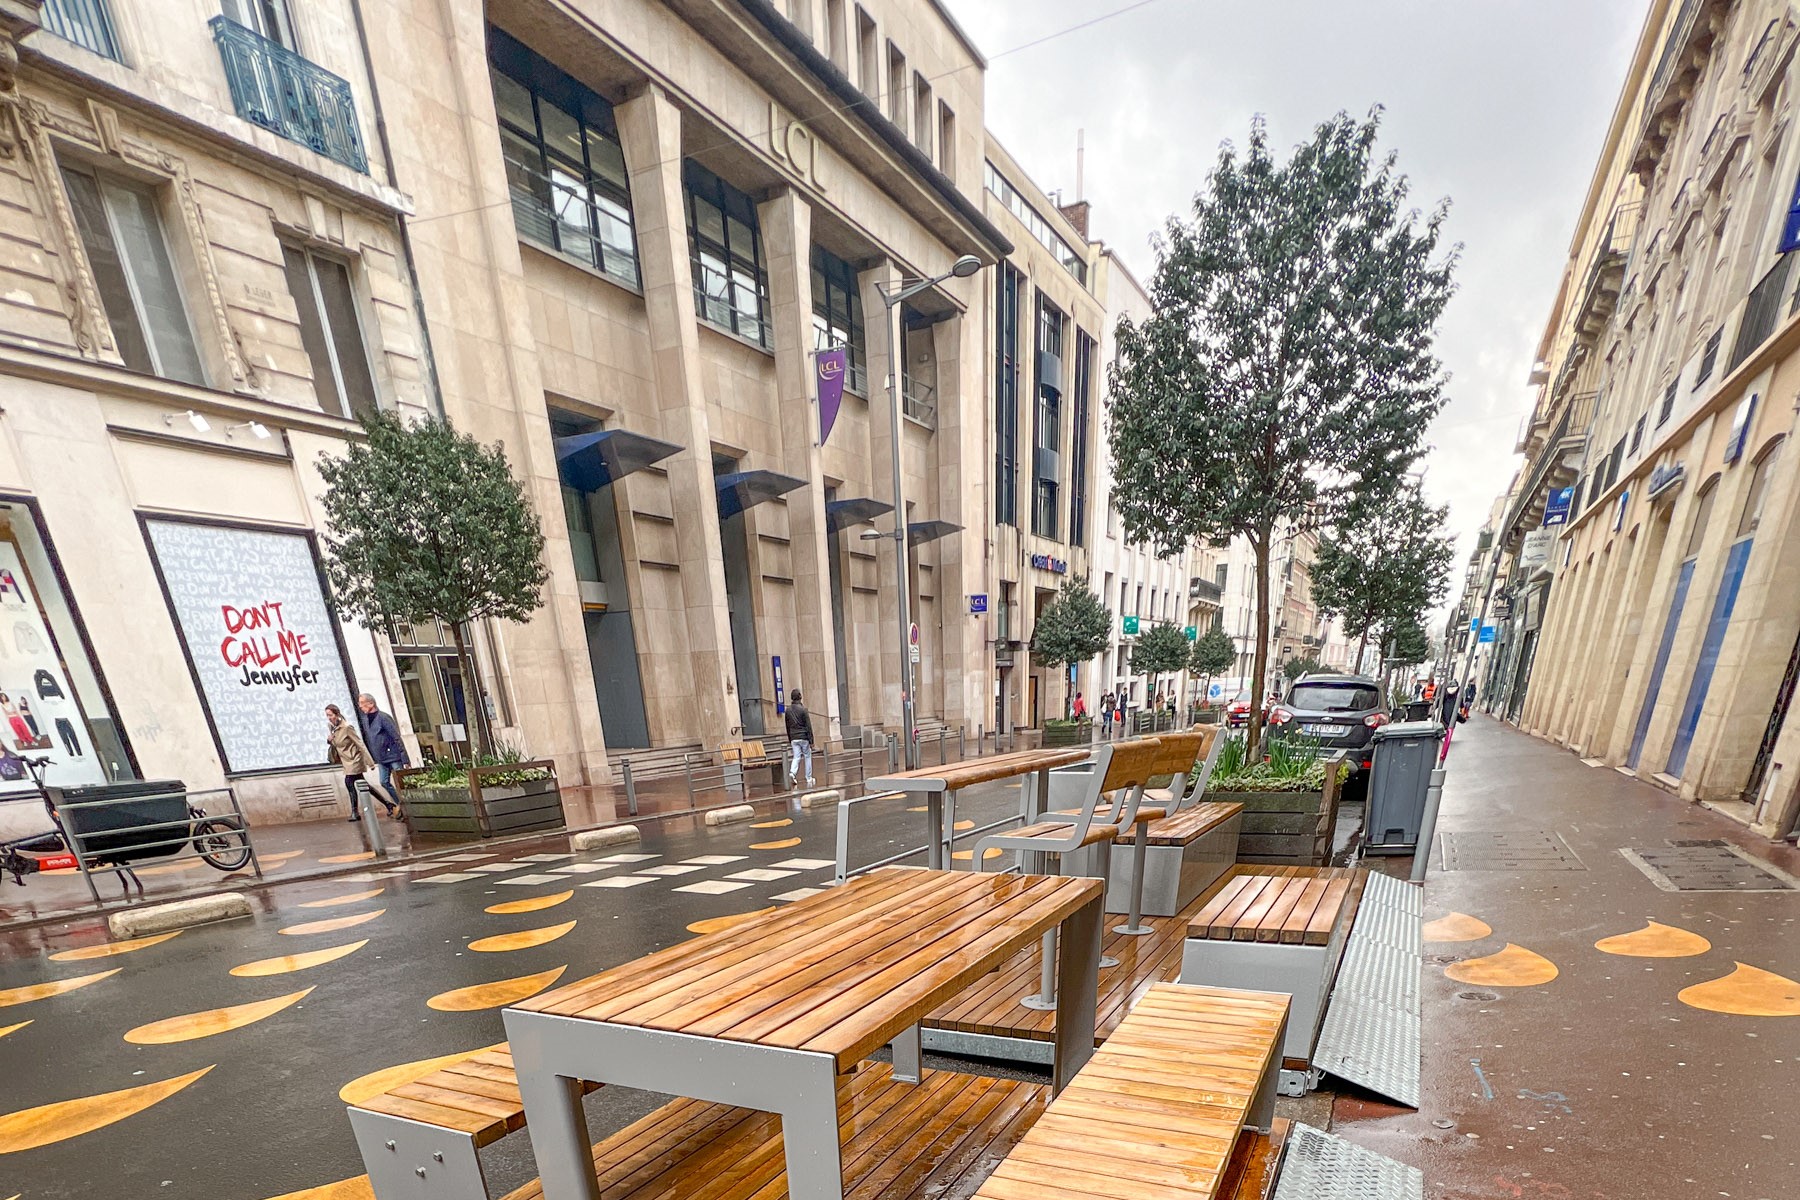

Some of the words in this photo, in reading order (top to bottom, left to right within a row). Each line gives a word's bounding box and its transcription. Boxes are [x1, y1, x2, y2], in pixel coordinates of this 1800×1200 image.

[768, 101, 827, 193] LCL
[821, 360, 840, 371] LCL
[221, 600, 286, 633] DON'T
[221, 636, 281, 668] CALL
[277, 630, 311, 667] ME
[240, 664, 319, 692] Jennyfer
